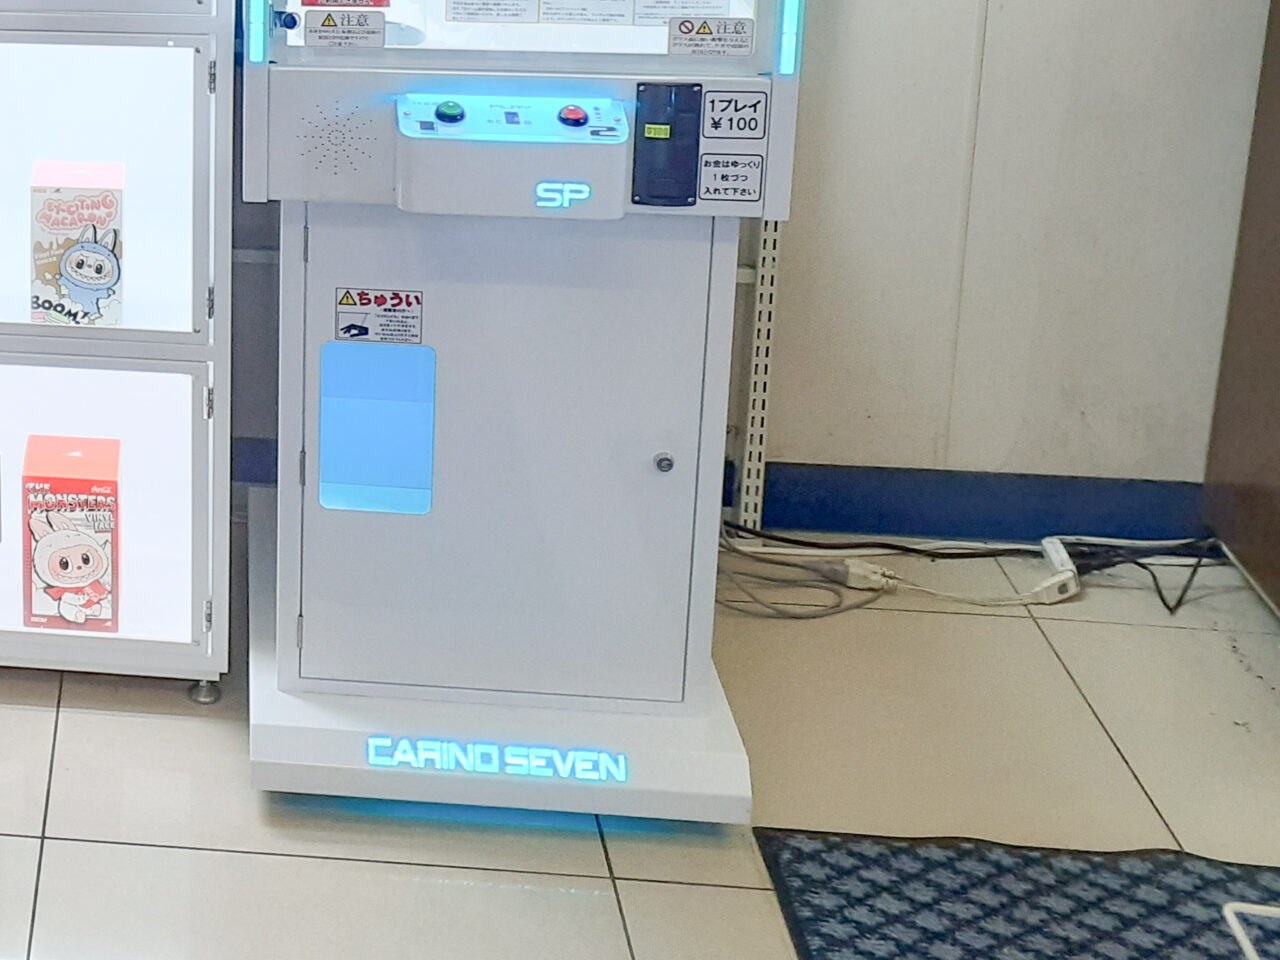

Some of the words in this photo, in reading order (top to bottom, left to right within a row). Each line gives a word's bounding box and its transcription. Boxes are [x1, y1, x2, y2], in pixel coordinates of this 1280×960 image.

[340, 13, 370, 27] 注意
[716, 20, 748, 35] 注意
[708, 98, 762, 114] 1プレイ
[710, 116, 759, 132] ¥100
[703, 159, 761, 169] お金はゆっくり
[534, 181, 592, 209] SP
[703, 186, 757, 196] 入れて下さい
[357, 290, 422, 308] ちゅうい
[27, 493, 117, 514] MONSTERS
[366, 736, 500, 774] CARINO
[504, 745, 628, 782] SEVEN
